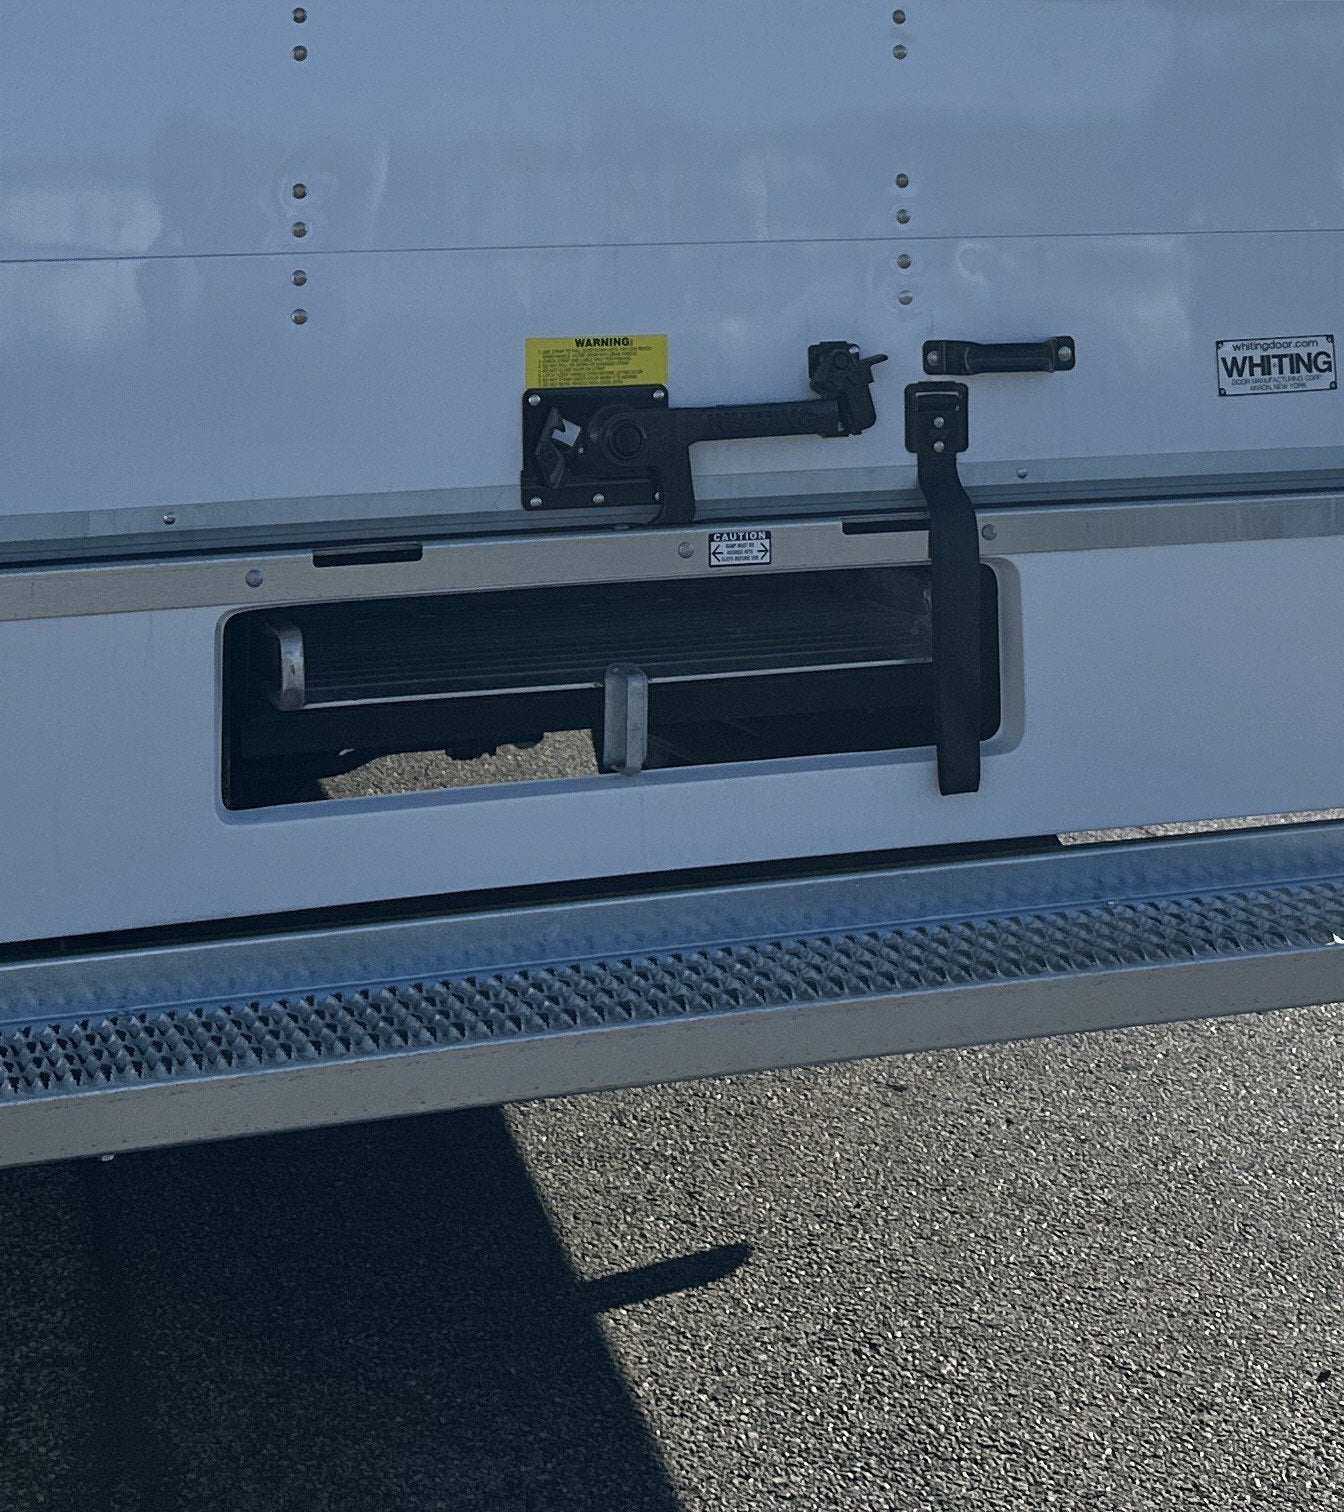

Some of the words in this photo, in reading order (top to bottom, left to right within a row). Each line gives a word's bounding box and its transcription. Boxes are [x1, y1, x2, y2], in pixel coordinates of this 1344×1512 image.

[1232, 339, 1319, 352] whitingdoor.com
[1221, 351, 1333, 378] WHITING
[713, 531, 766, 542] CAUTION
